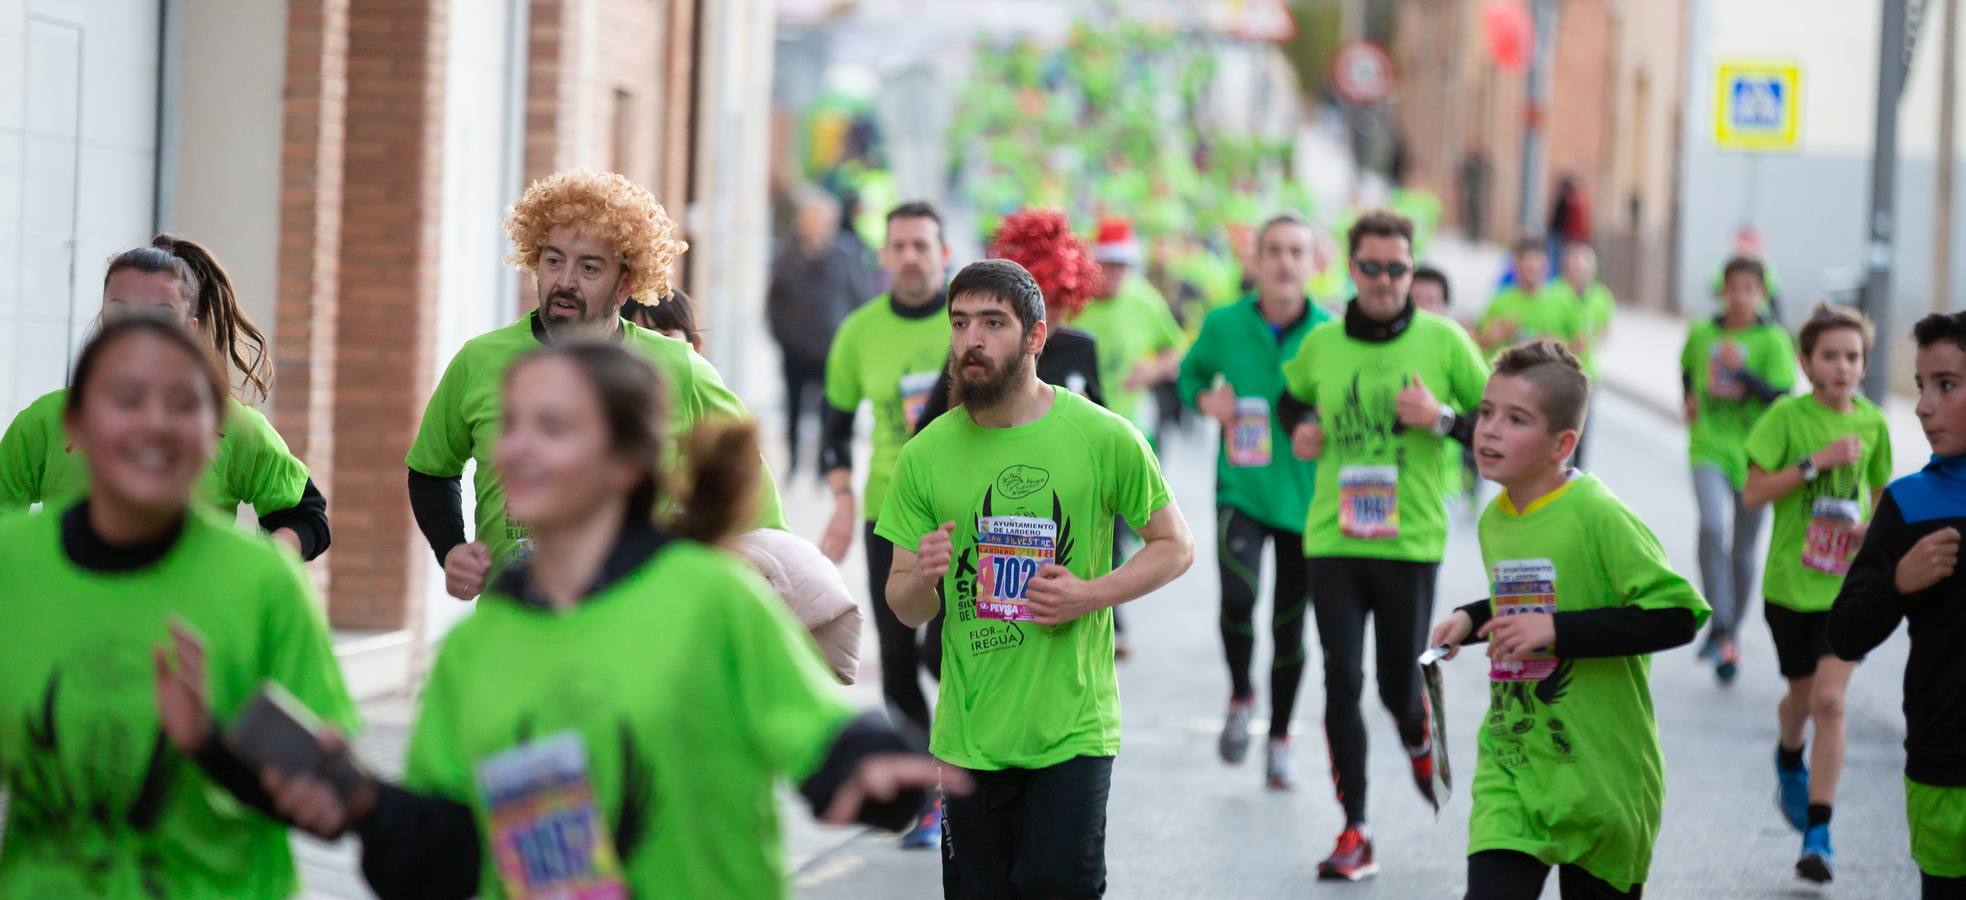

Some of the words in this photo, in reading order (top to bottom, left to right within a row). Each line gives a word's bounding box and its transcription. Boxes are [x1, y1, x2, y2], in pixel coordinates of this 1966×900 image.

[993, 520, 1054, 530] AYUNTAMIENTO
[1006, 528, 1041, 536] LARDERO
[993, 556, 1037, 599] 702
[970, 626, 996, 640] FLOR
[971, 634, 1018, 651] IREGUA
